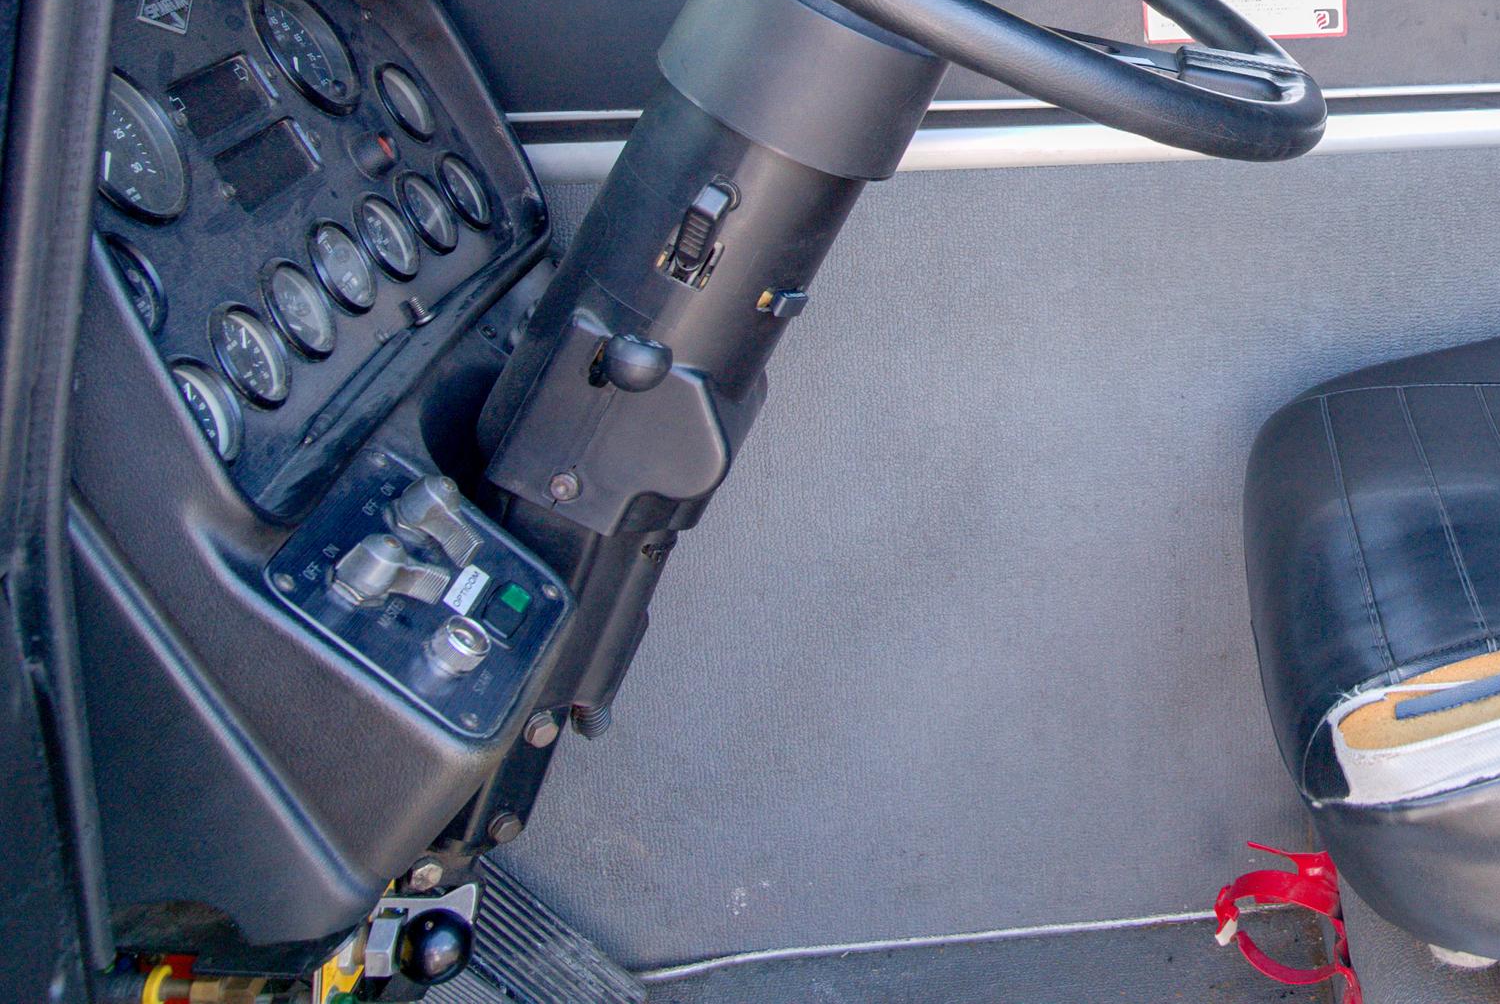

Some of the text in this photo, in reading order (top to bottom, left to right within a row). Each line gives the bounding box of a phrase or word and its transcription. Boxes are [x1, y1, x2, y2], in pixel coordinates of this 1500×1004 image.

[113, 128, 125, 140] 25
[130, 162, 143, 174] 30
[362, 482, 396, 516] OFF ON
[302, 543, 340, 581] OFF ON
[453, 570, 481, 608] OPTICOM
